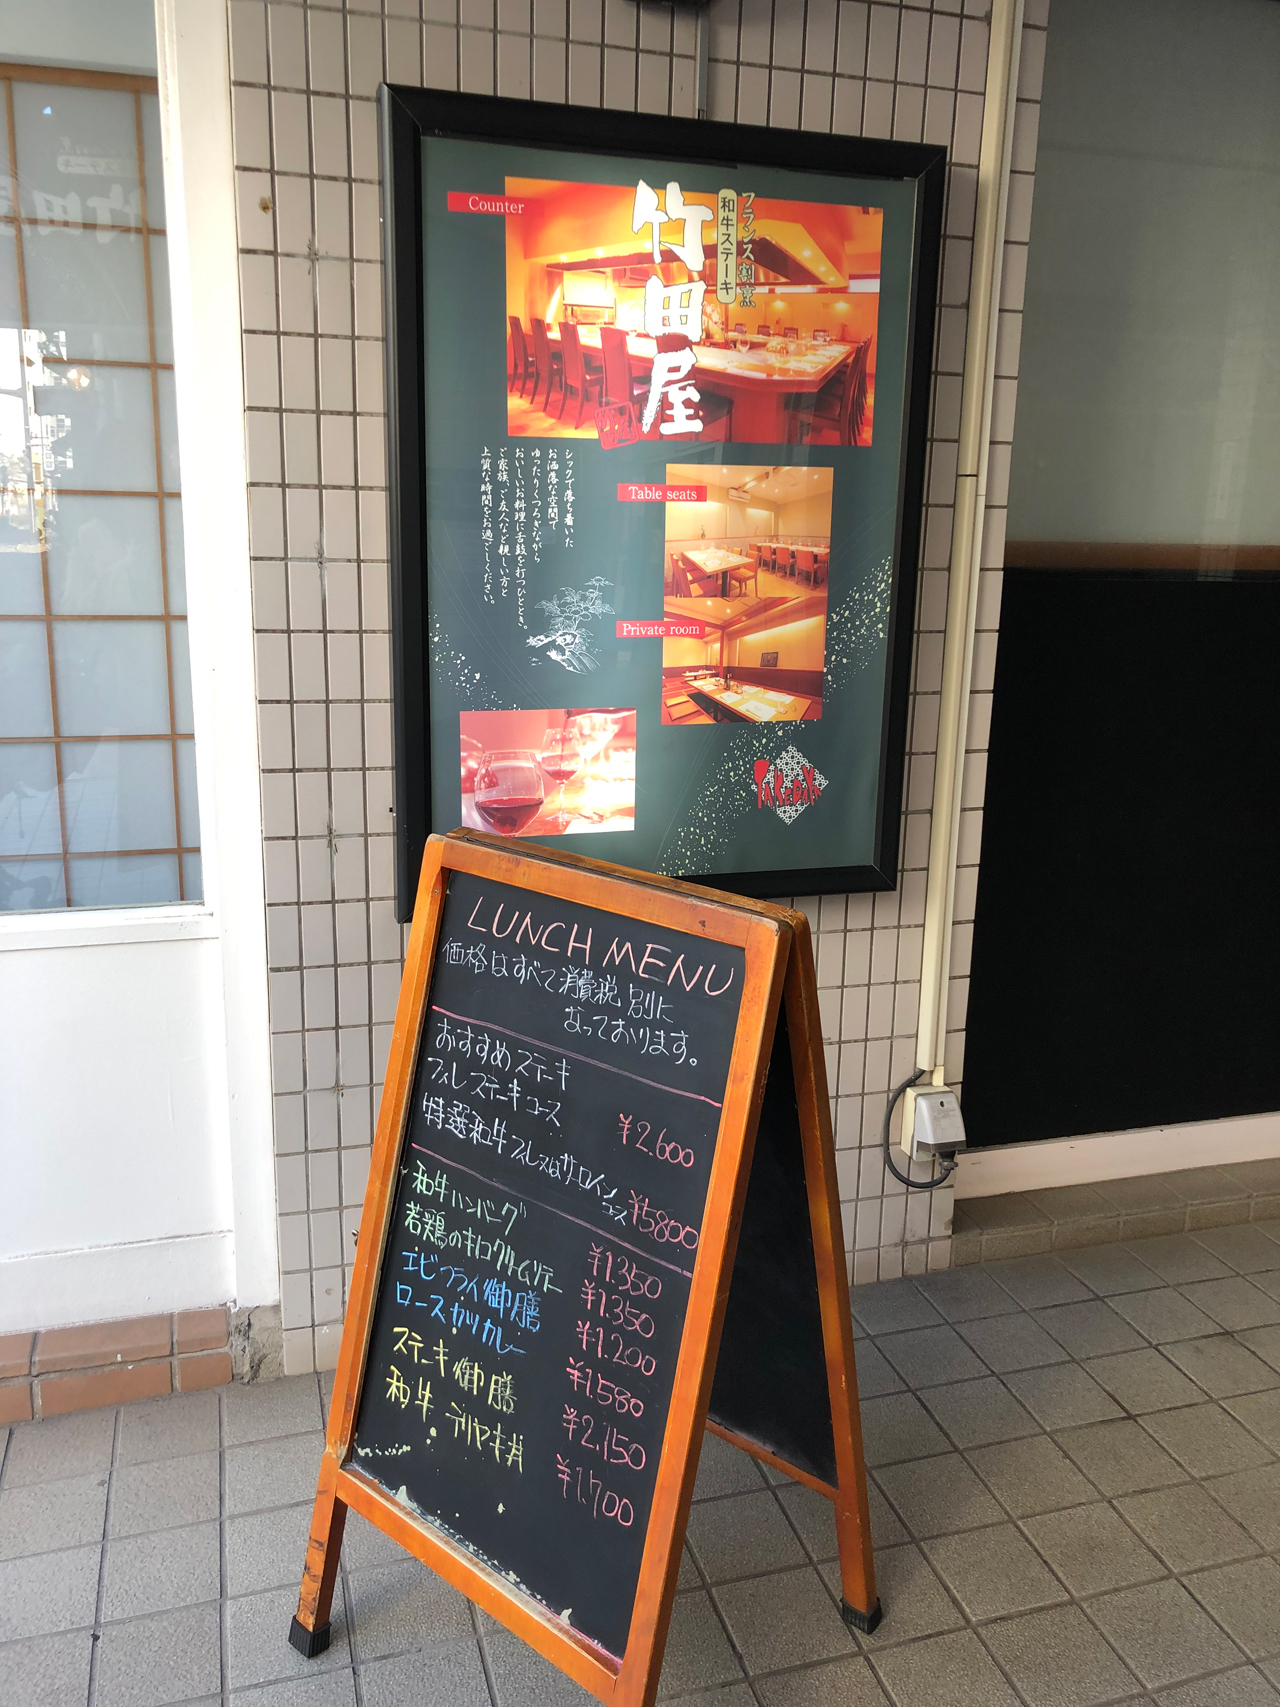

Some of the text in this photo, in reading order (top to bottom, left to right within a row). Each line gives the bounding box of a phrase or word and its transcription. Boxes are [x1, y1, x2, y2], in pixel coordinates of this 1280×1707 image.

[468, 195, 525, 214] Counter
[719, 196, 736, 297] 和牛ステーキ
[737, 191, 757, 308] フランス割烹
[632, 178, 715, 436] 竹田屋
[480, 445, 496, 605] 上質な時間をお過ごしください。
[497, 446, 512, 598] ご家族、ご友人など親しい方と
[513, 446, 528, 630] おいしいお料理に舌鼓を打つひととき。
[531, 447, 543, 564] ゆったりくつろぎながら
[563, 448, 576, 548] シックで落ち着いた
[628, 486, 698, 500] Table seats
[622, 623, 700, 636] Private room
[467, 896, 735, 997] LUNCH MENU
